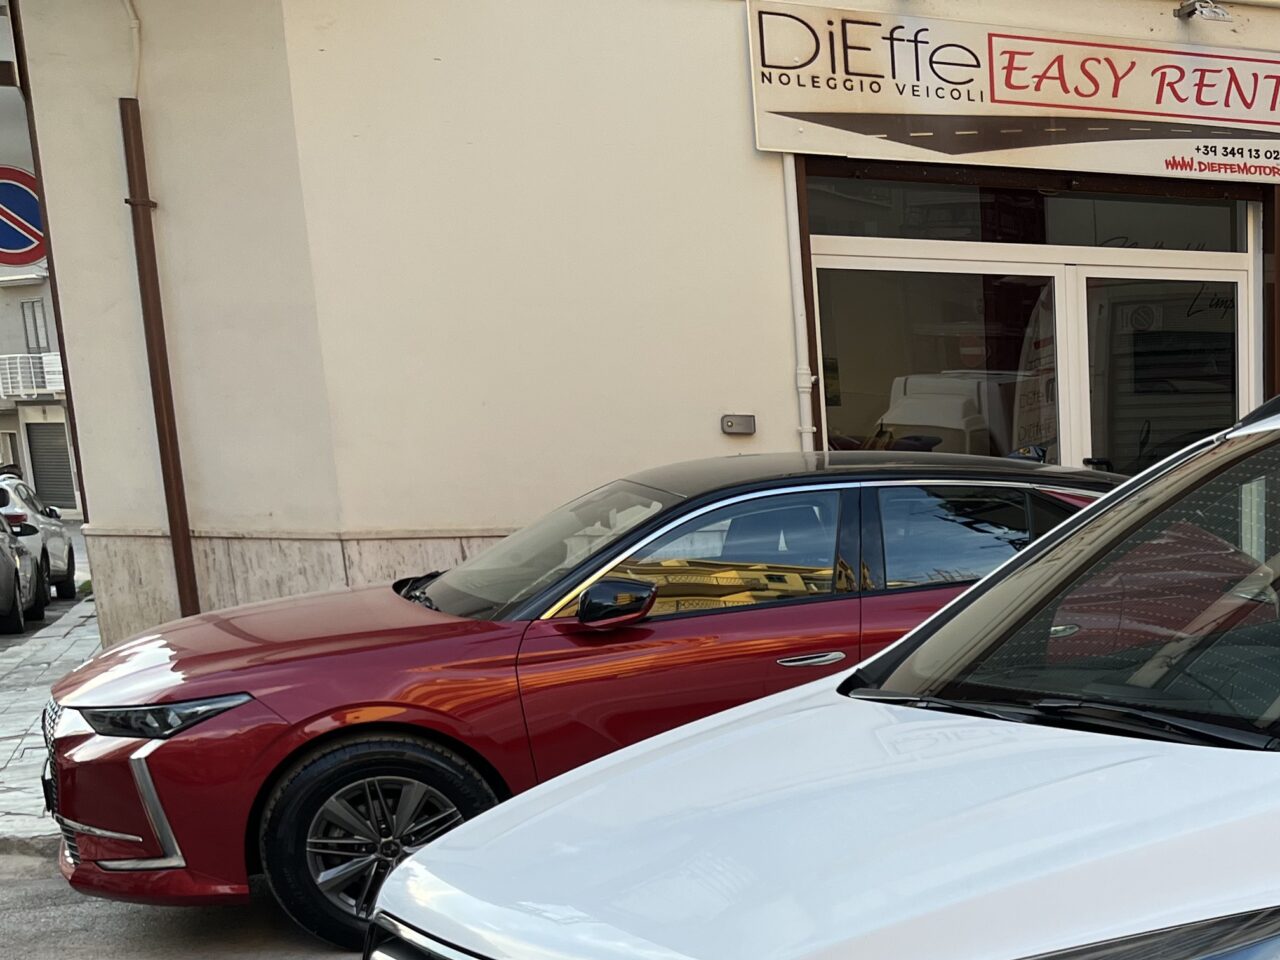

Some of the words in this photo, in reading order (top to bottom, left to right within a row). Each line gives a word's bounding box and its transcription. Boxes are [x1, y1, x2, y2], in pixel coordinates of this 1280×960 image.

[758, 10, 981, 86] DiEffe
[761, 71, 882, 94] NOLEGGIO
[895, 83, 984, 103] VEICOLI
[1000, 50, 1137, 99] EASY
[1194, 144, 1217, 157] +39
[1221, 146, 1244, 159] 349
[1247, 148, 1261, 160] 13
[1264, 149, 1280, 161] 02
